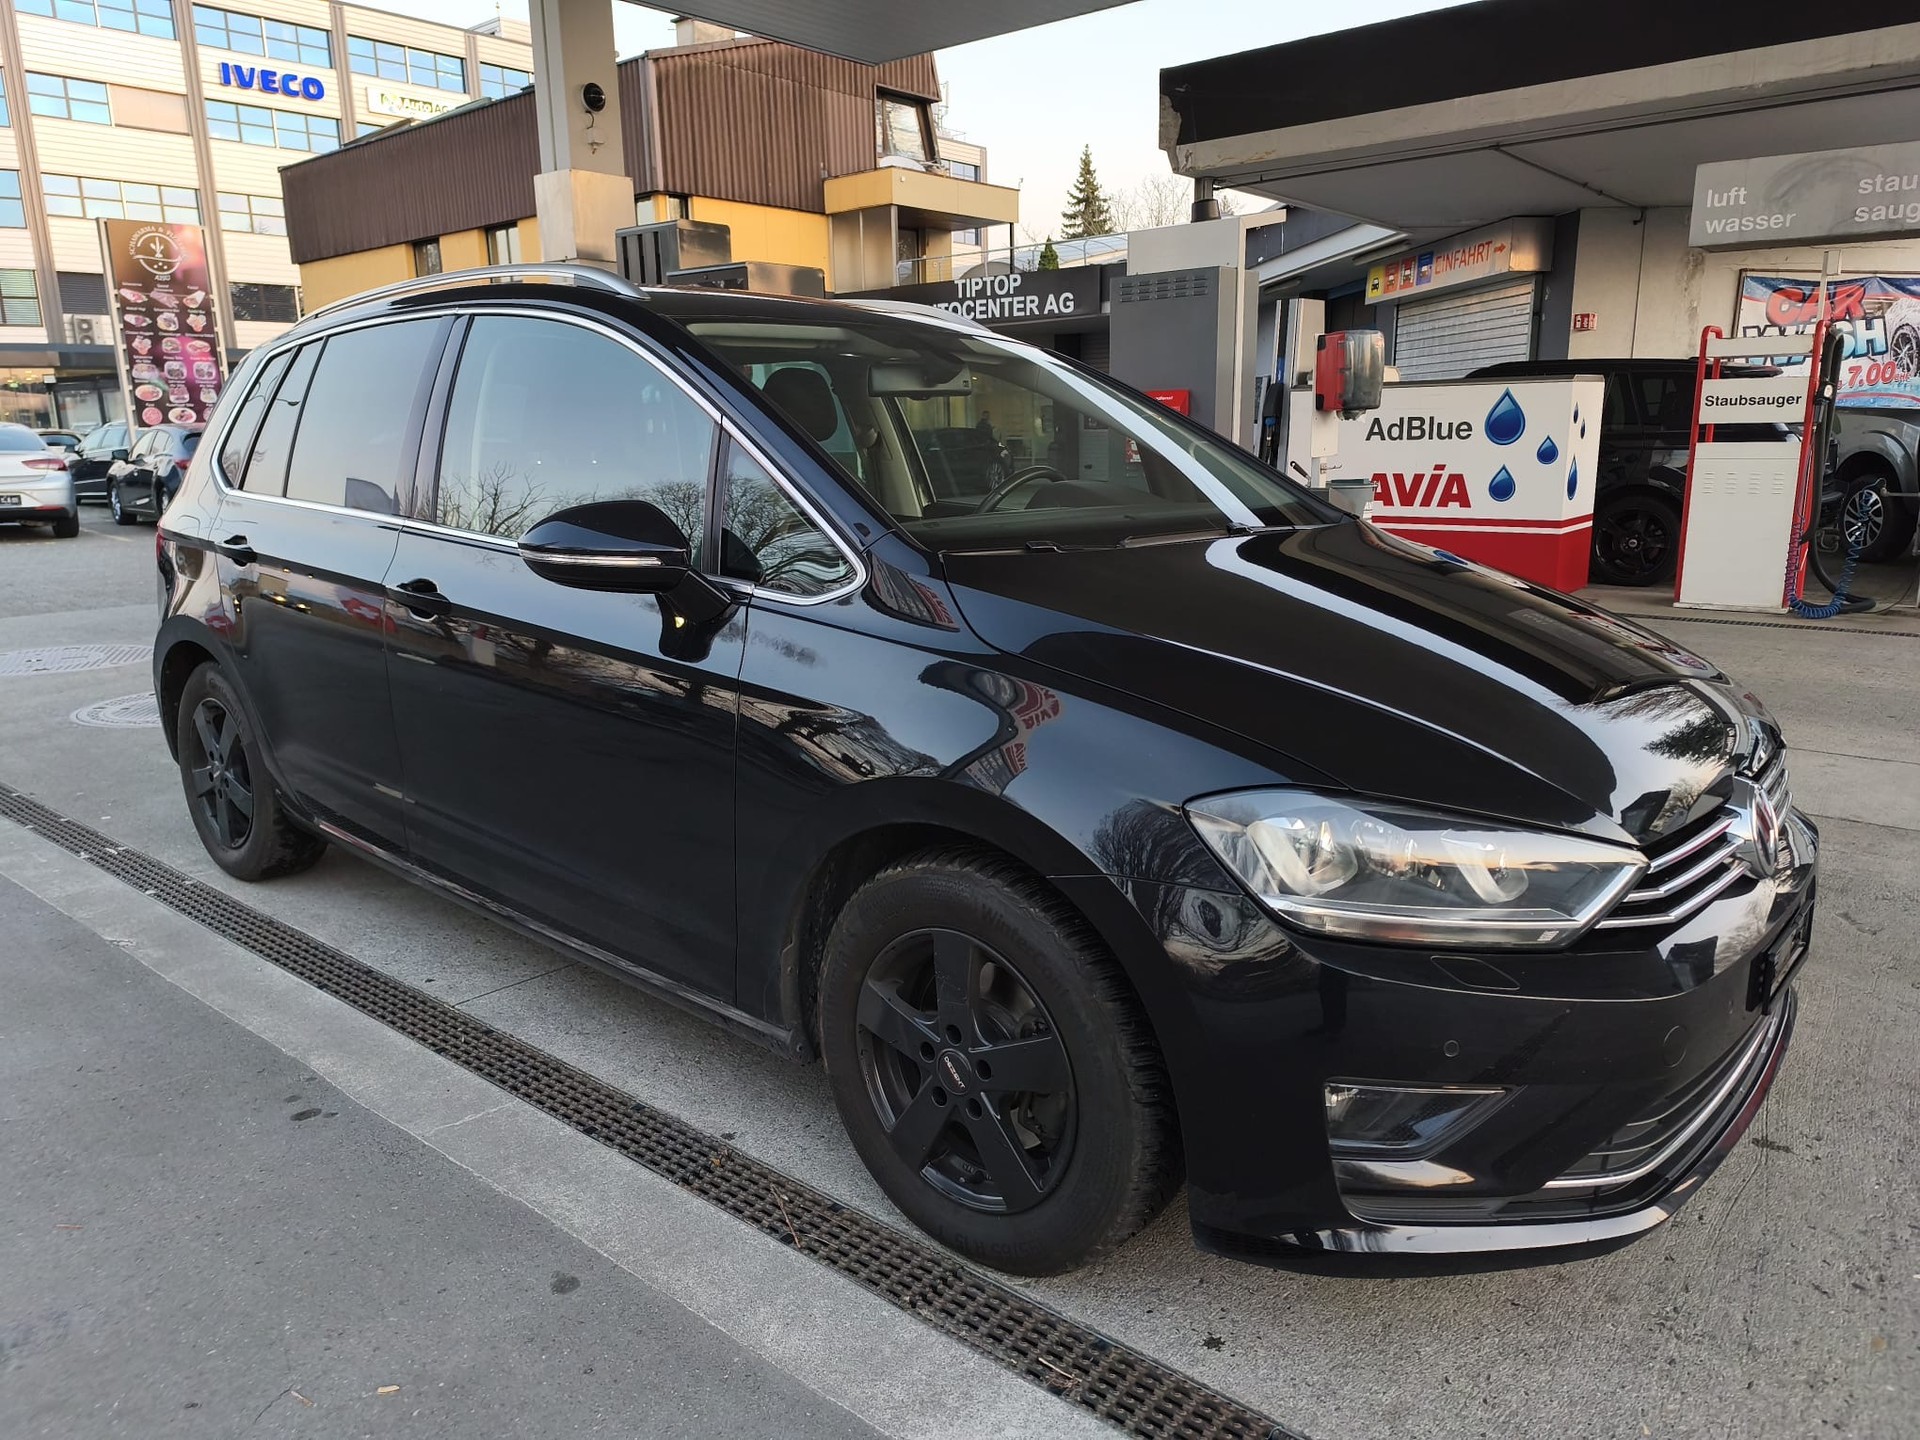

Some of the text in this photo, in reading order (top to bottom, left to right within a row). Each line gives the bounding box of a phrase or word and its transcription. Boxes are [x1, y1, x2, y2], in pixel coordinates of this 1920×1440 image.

[220, 62, 325, 100] IVECO
[1857, 174, 1919, 194] stau
[1706, 187, 1747, 208] luft
[1705, 212, 1797, 234] wasser
[1854, 202, 1920, 223] saug
[1434, 240, 1493, 275] EINFAHRT
[954, 273, 1022, 299] TIPTOP
[1043, 292, 1075, 315] AG
[1766, 284, 1866, 327] CAR
[1847, 360, 1897, 389] 7.00
[1704, 394, 1802, 408] Staubsauger
[1365, 416, 1473, 441] AdBlue
